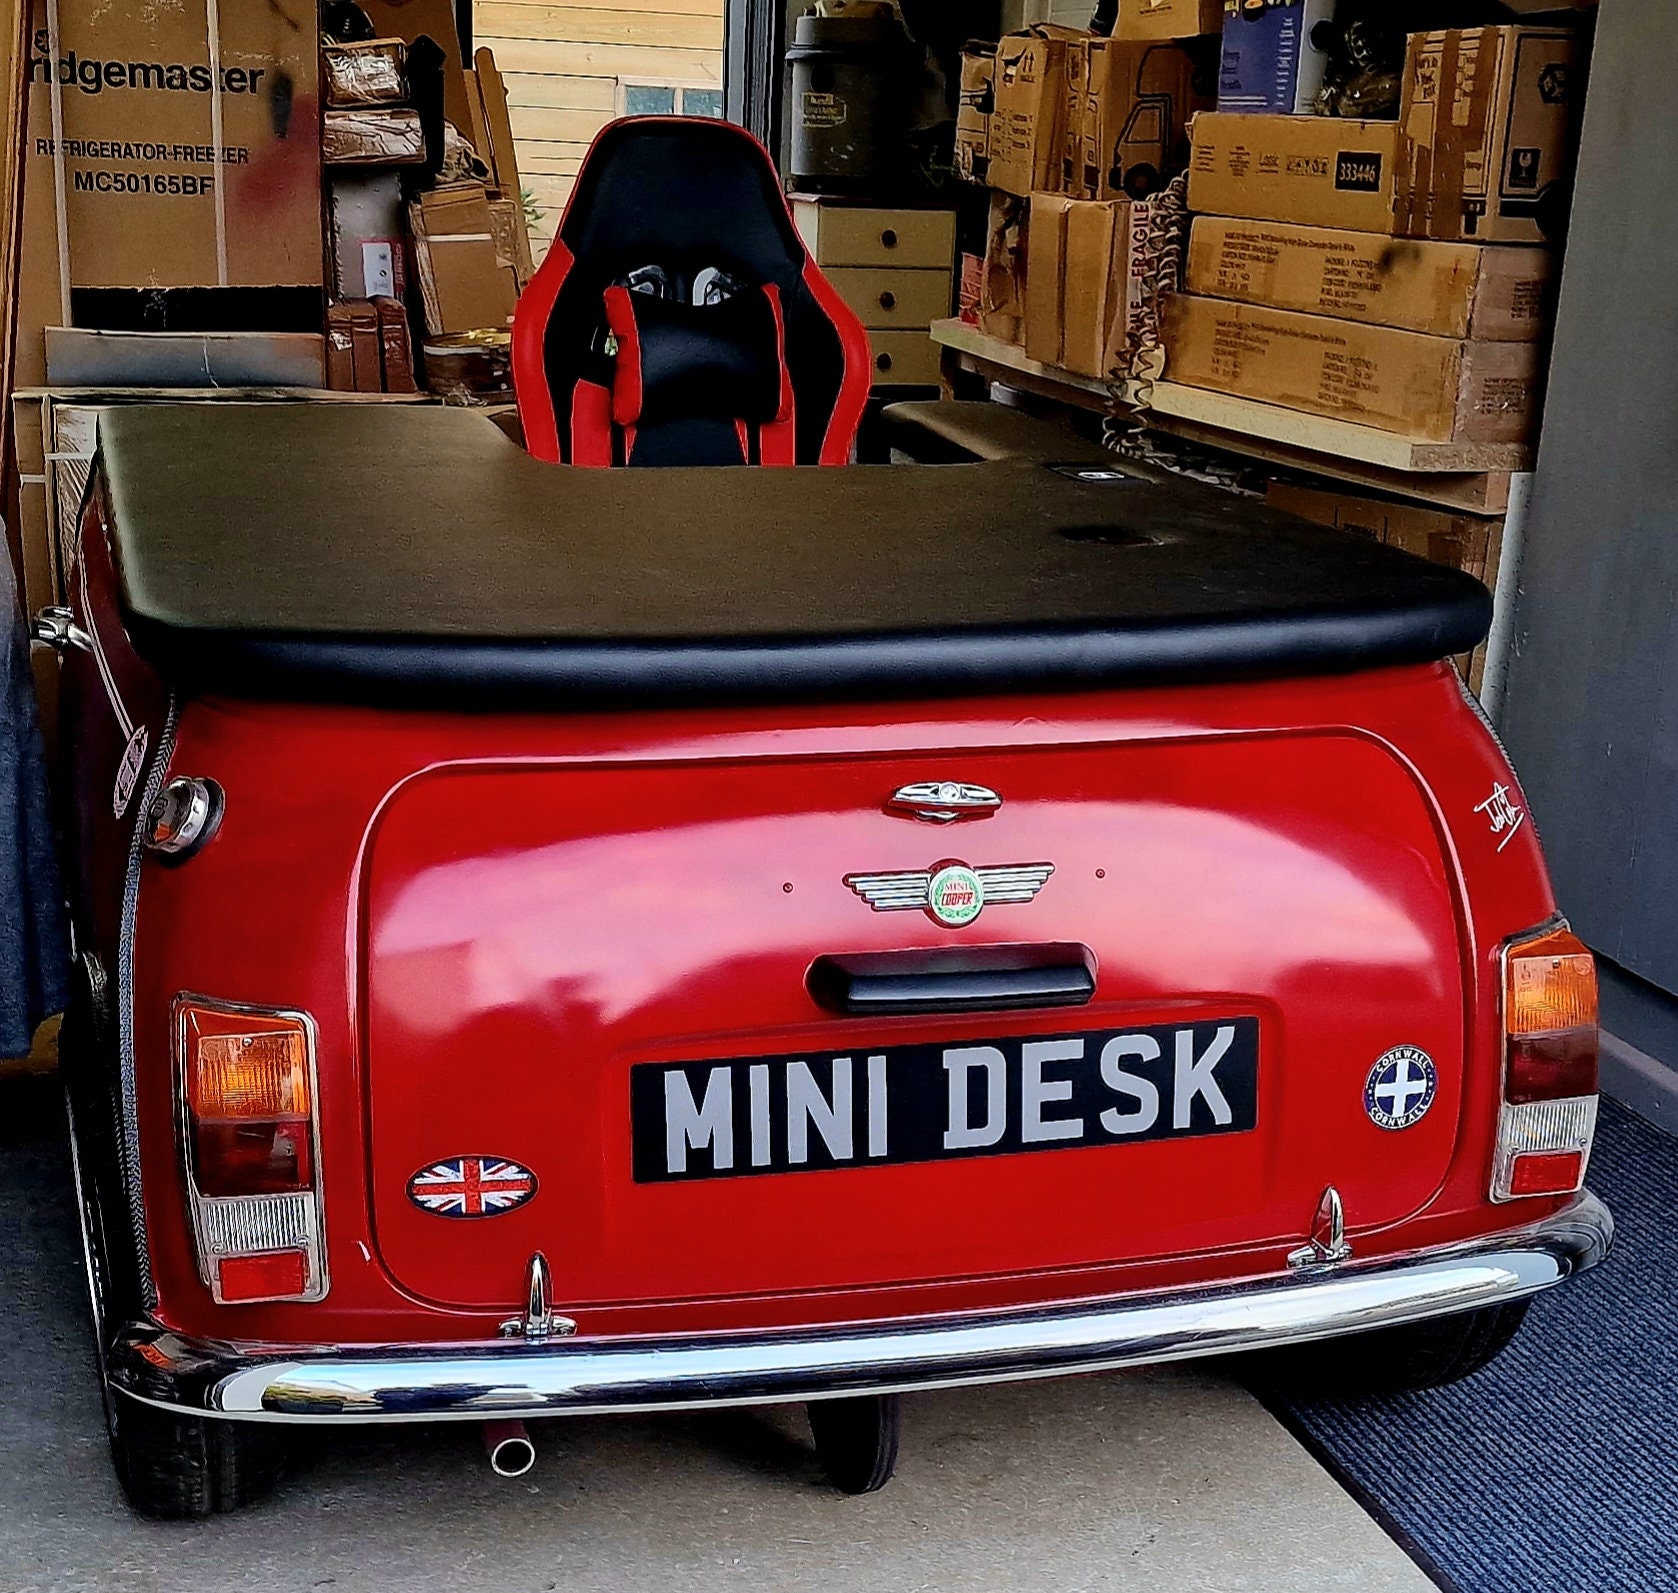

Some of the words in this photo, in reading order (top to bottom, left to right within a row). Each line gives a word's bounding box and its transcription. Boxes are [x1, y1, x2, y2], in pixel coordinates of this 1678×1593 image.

[29, 50, 265, 95] ridgemaser
[74, 170, 215, 195] MC50165BF
[1131, 204, 1149, 278] FRAGILE
[945, 882, 968, 891] MINI
[942, 892, 973, 906] COOPER
[1376, 1049, 1429, 1073] CORNWALL
[664, 1055, 888, 1173] MINI
[943, 1026, 1236, 1150] DESK
[1371, 1103, 1428, 1126] CORNWALL
